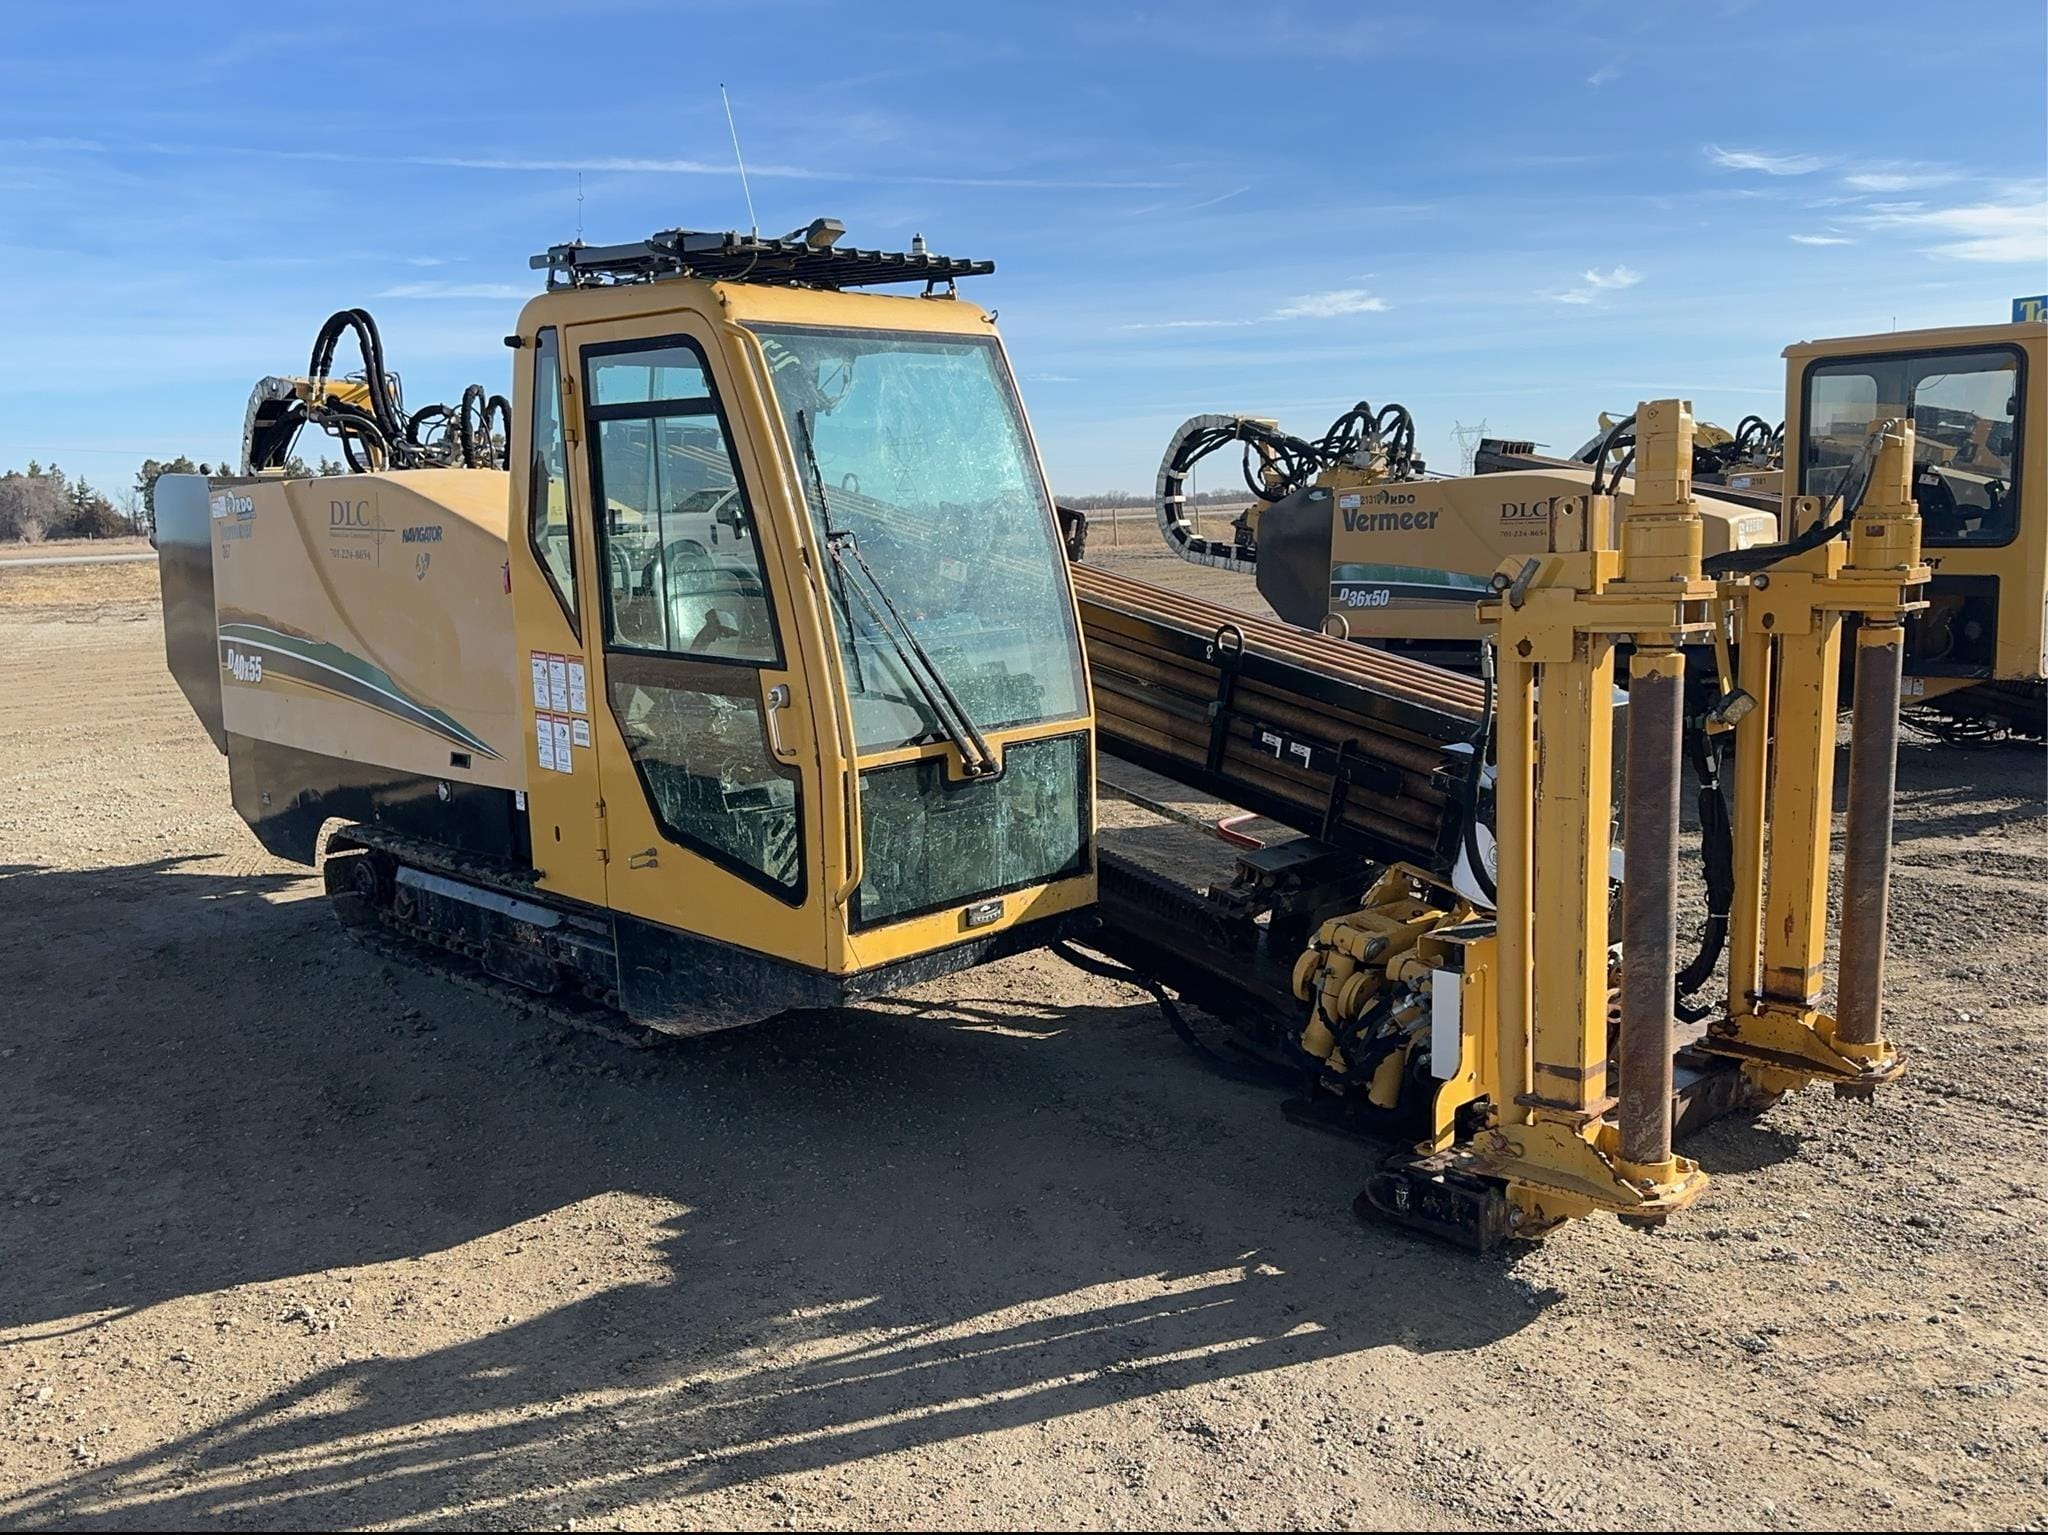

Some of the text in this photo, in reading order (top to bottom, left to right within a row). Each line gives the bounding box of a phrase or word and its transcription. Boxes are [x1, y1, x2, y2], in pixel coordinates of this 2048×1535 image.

[329, 500, 370, 527] DLC
[1342, 508, 1439, 532] Vermeer
[1500, 501, 1548, 518] DLC
[402, 525, 443, 543] NAVIGATOR
[1339, 587, 1390, 607] D36x50
[227, 648, 263, 683] D40x55
